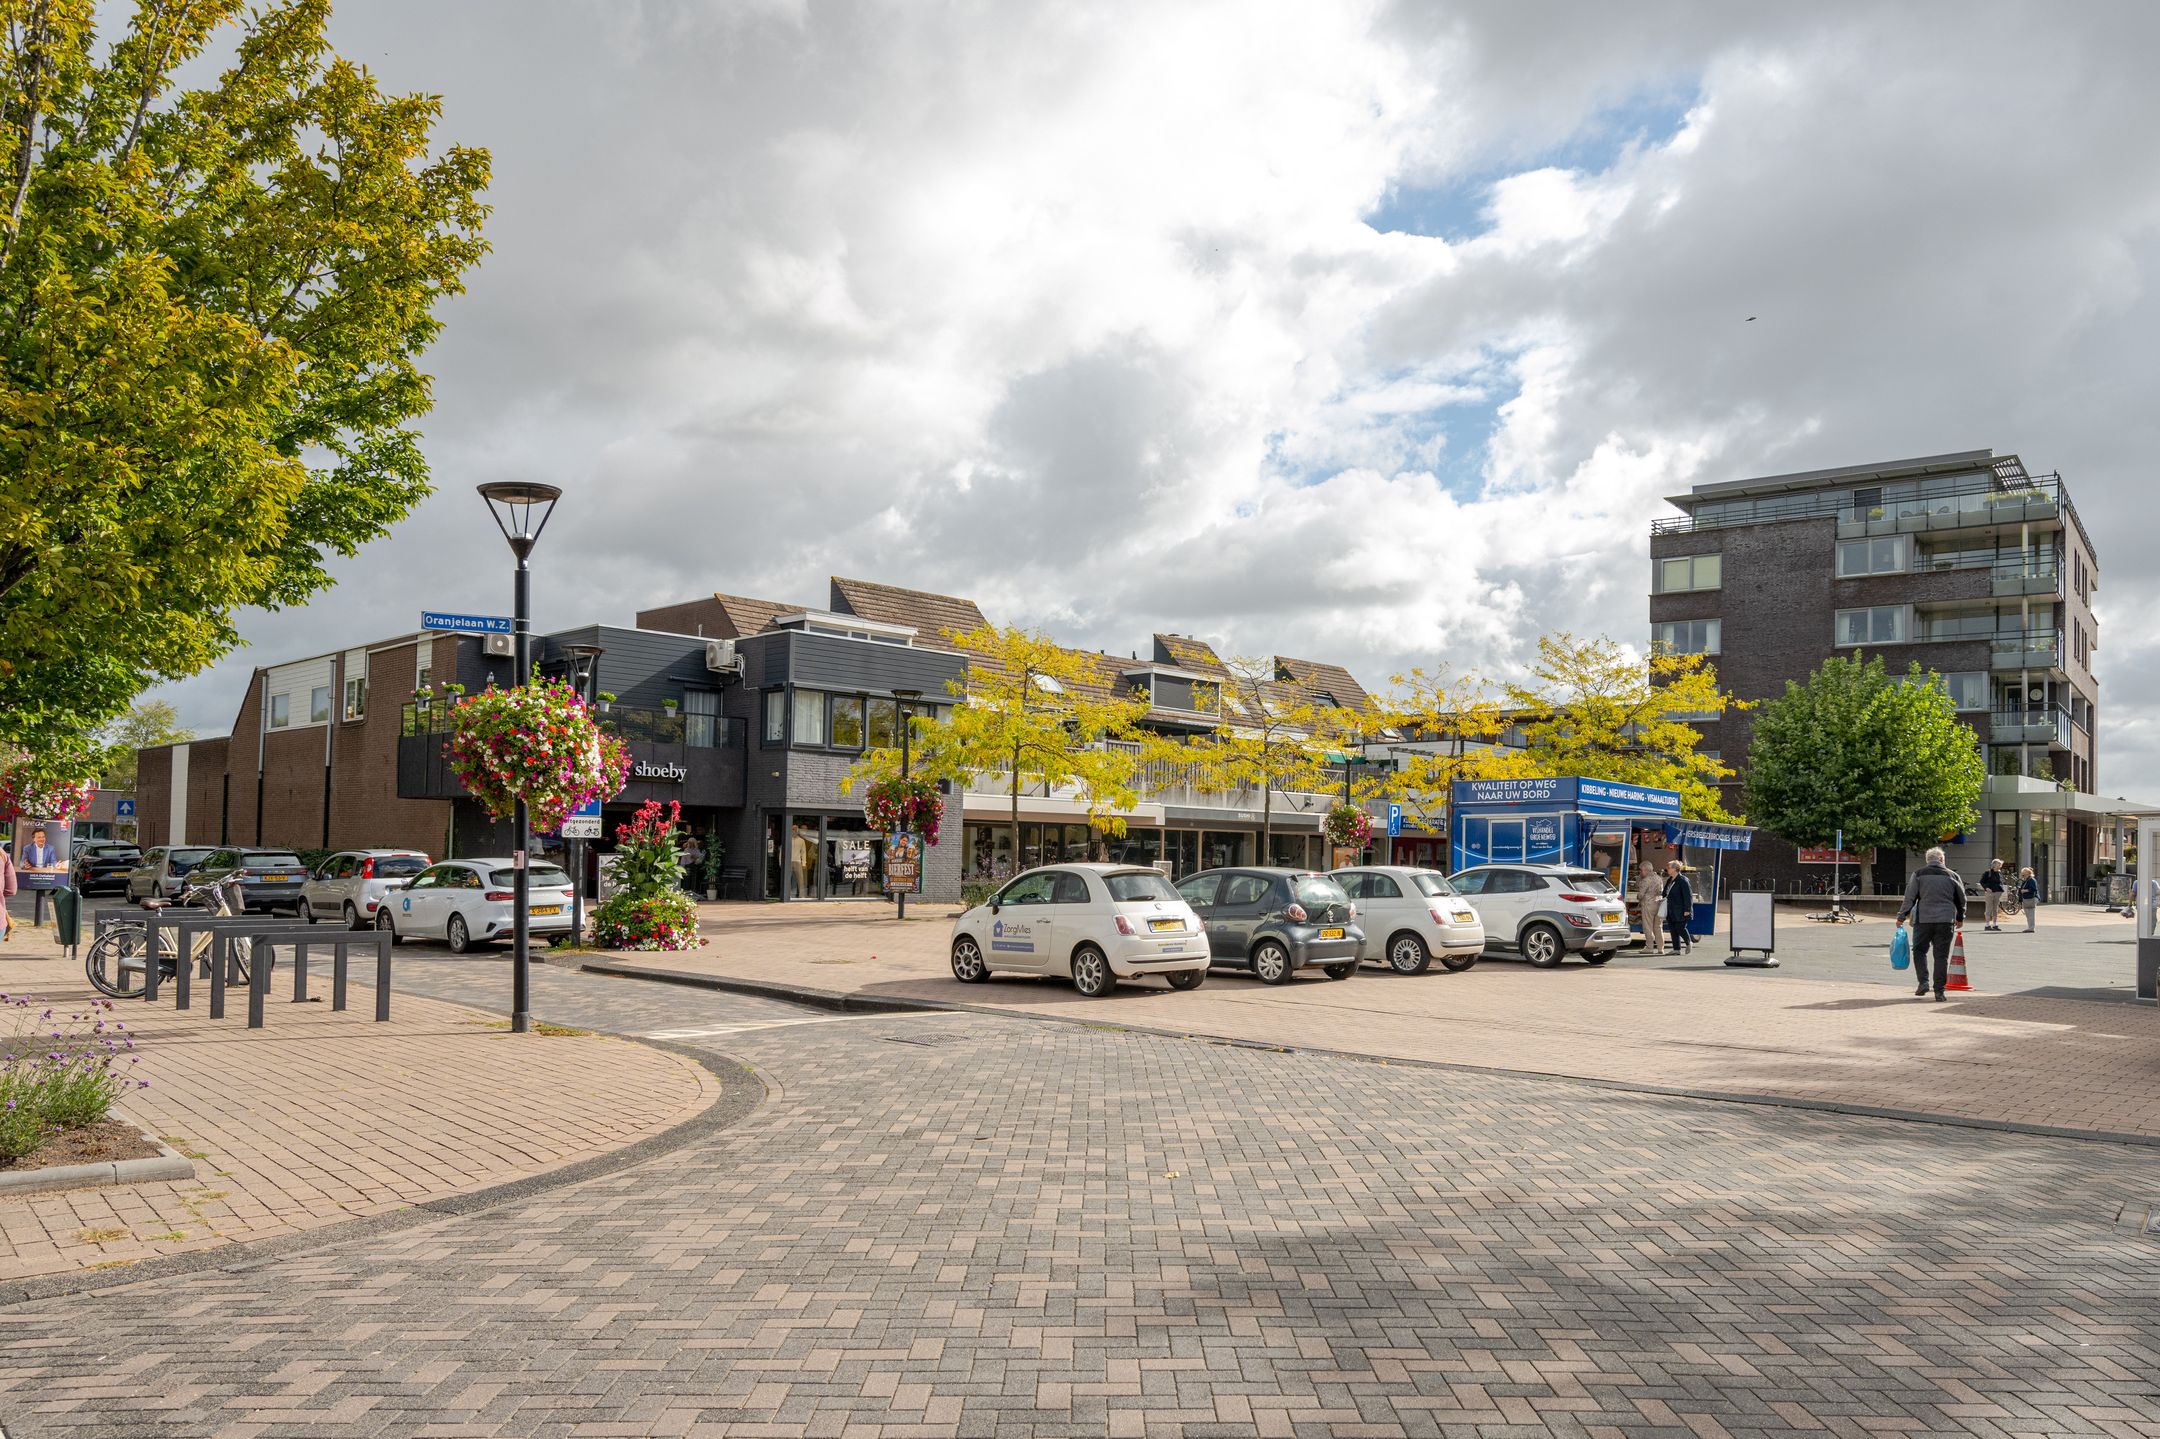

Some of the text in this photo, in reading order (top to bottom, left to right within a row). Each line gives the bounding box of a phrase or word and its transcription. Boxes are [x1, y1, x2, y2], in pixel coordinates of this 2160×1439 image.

[425, 615, 509, 630] Oranjelaan W.Z.
[635, 760, 687, 782] shoeby
[1471, 779, 1557, 791] KWALITEIT OP WEG
[1581, 783, 1606, 797] KIBBELING
[1608, 787, 1628, 799] NIEUWE
[1627, 789, 1645, 802] HARING
[1477, 789, 1550, 800] NAAR UW BORD
[1391, 806, 1399, 823] P
[842, 840, 871, 850] SALE
